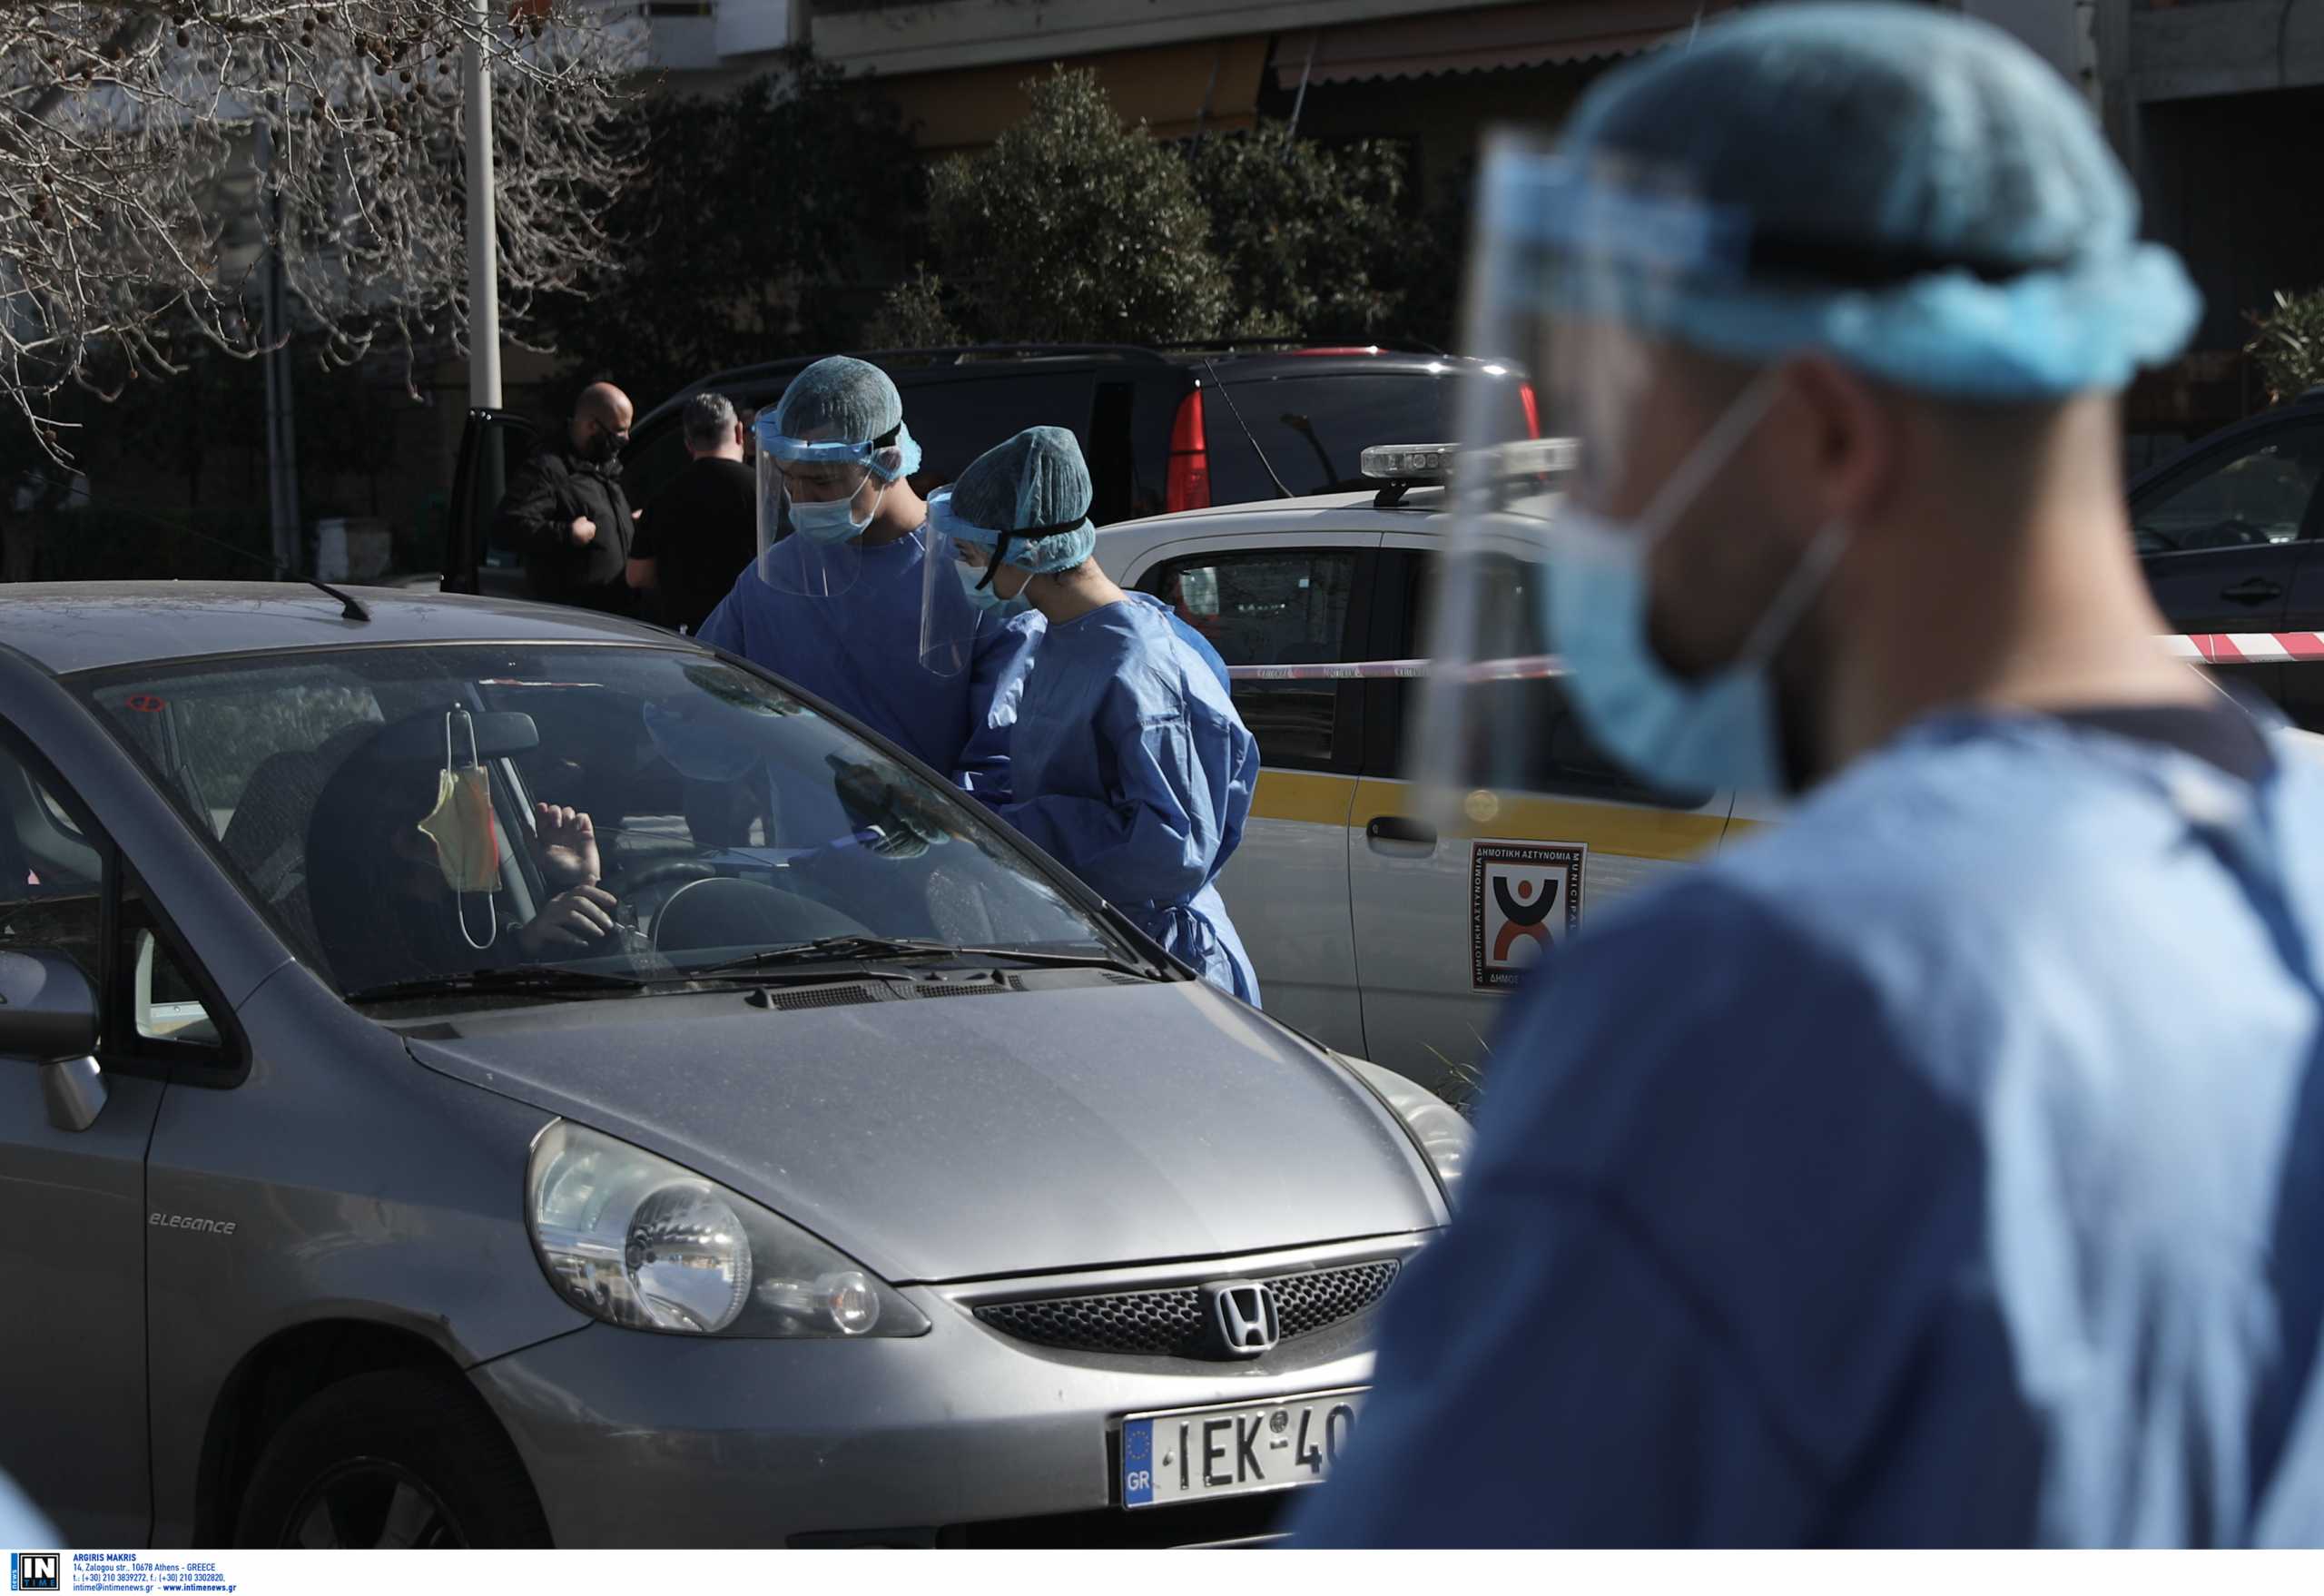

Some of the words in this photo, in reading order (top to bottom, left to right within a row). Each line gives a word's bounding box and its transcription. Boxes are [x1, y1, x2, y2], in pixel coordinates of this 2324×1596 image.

[1476, 848, 1521, 859] ΔΗΜΟΤΙΚΗ
[1521, 850, 1571, 861] ΑΣΤΥΝΟΜΙΑ
[1474, 857, 1483, 922] ΑΣΤΥΝΟΜΙΑ
[1474, 924, 1483, 983] ΔΗΜΟΤΙΚΗ
[1128, 1471, 1150, 1491] GR
